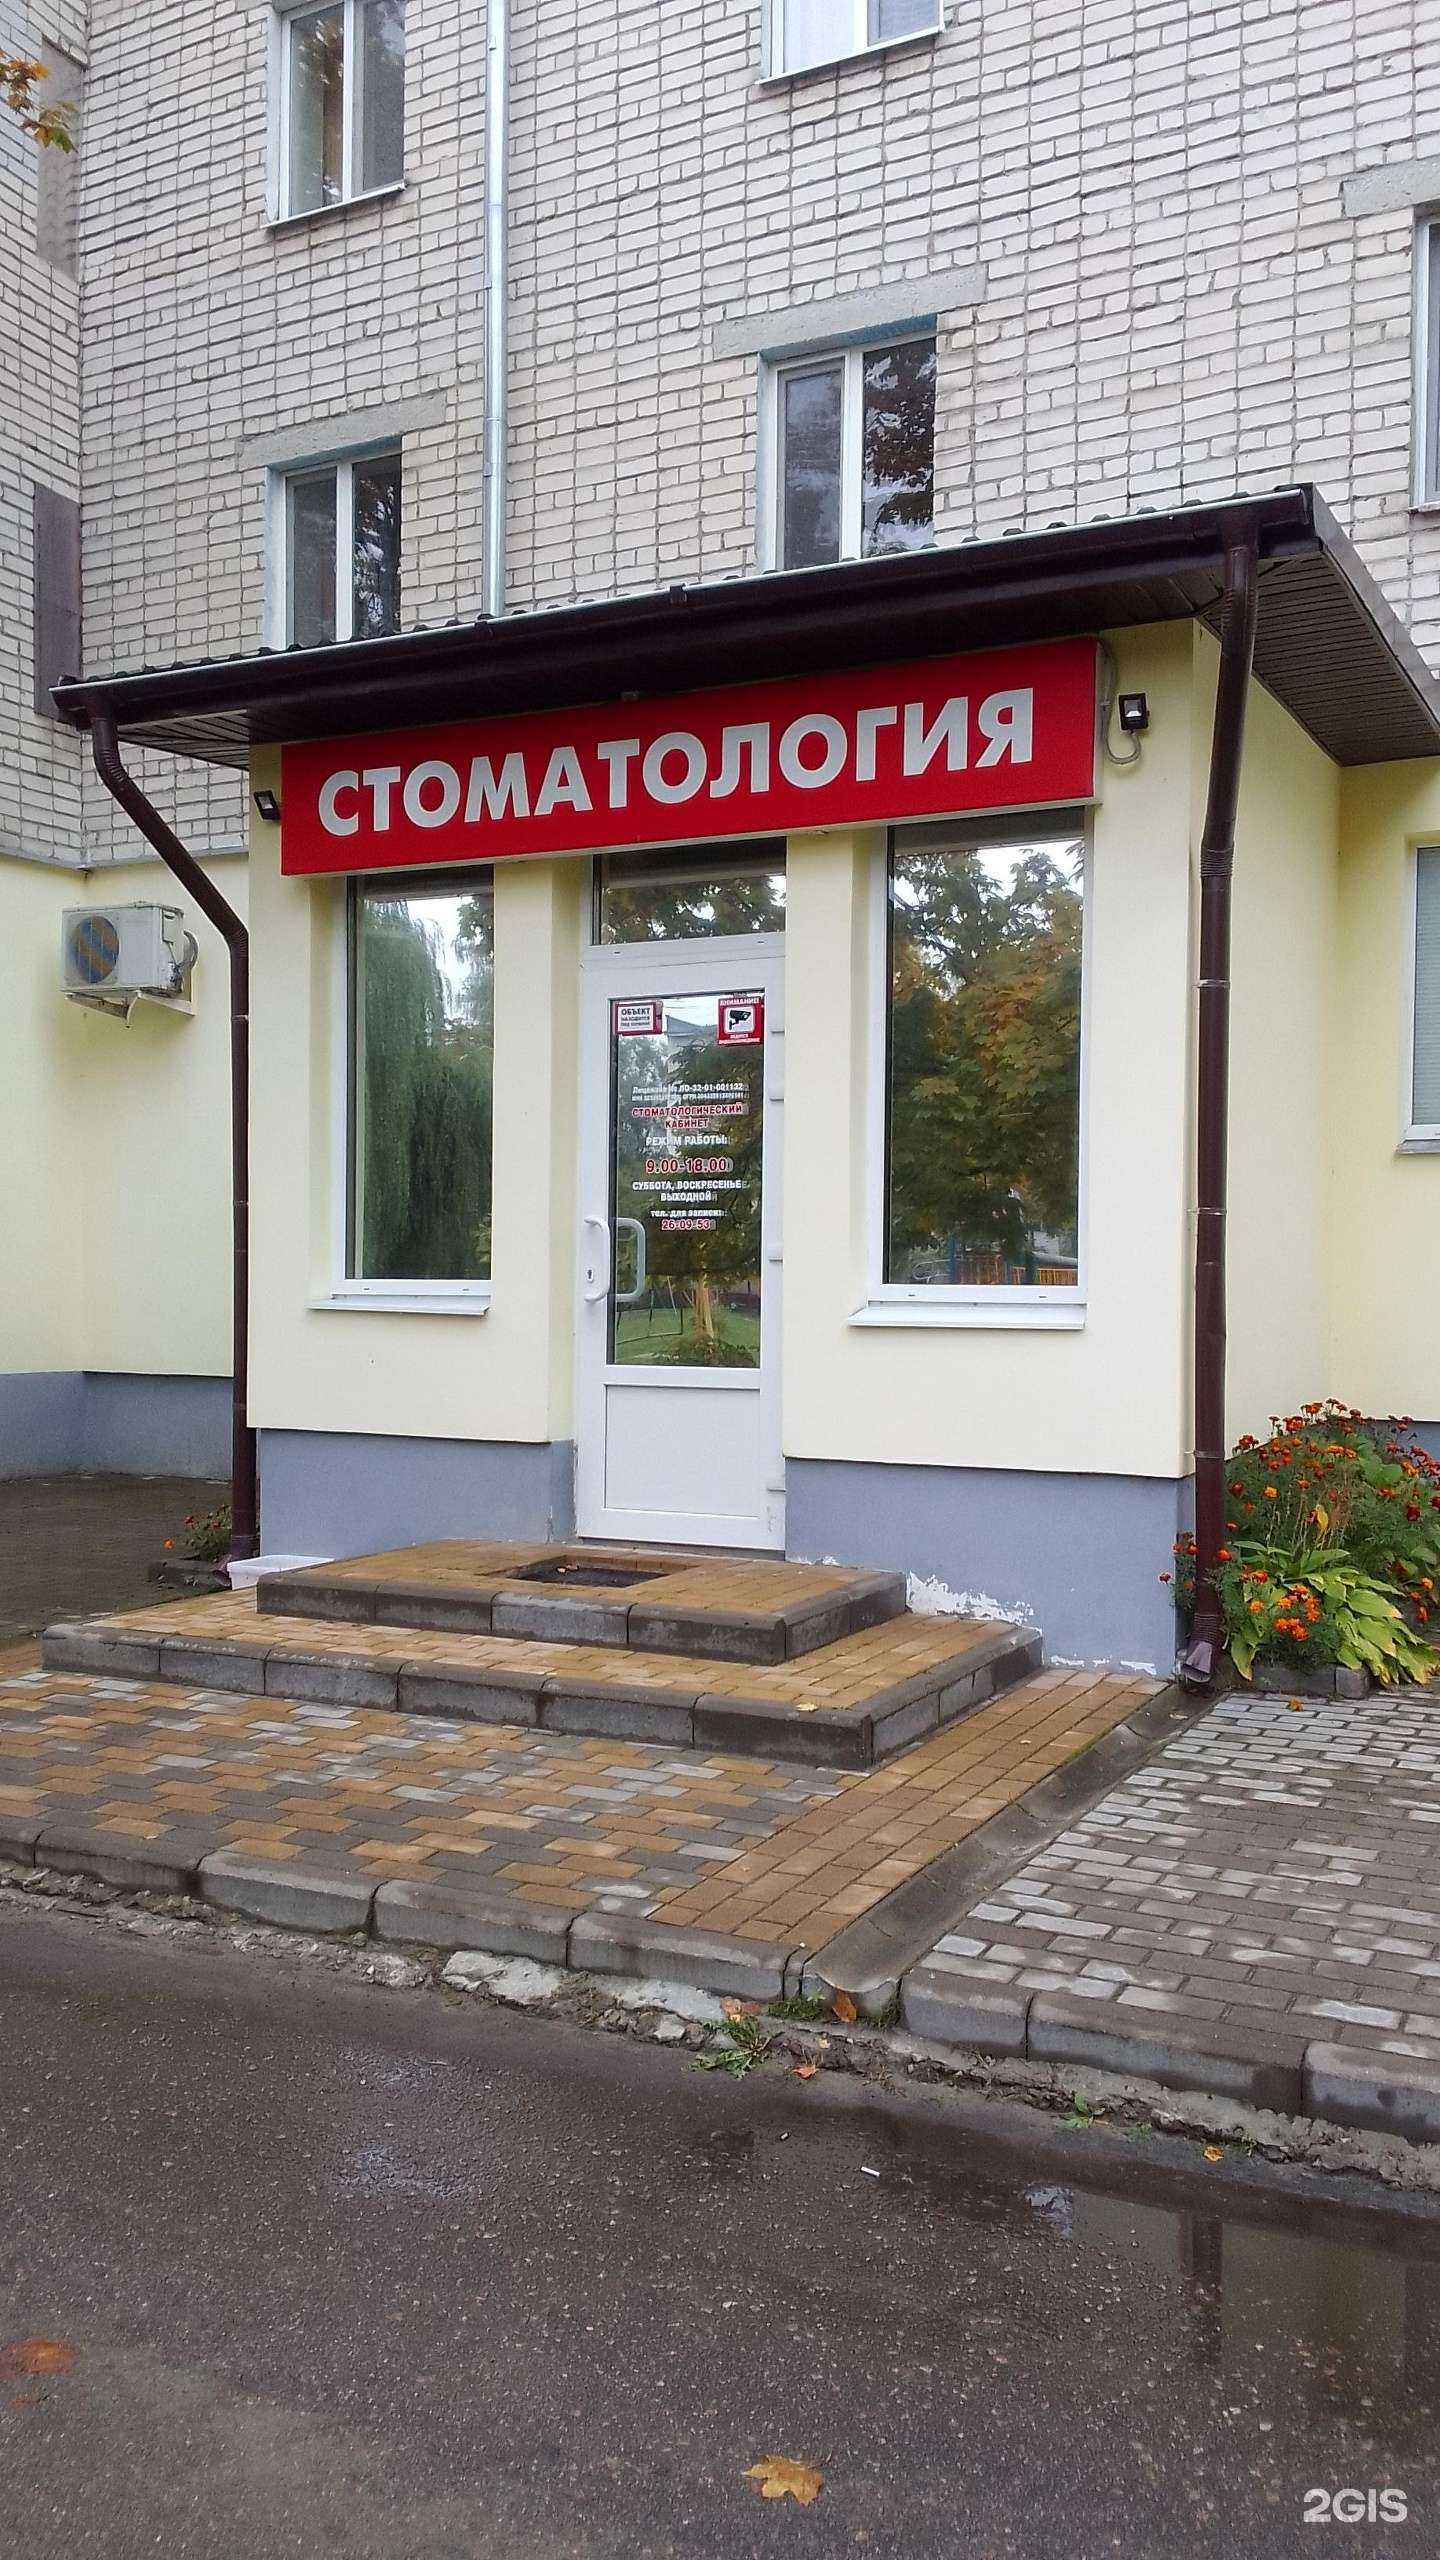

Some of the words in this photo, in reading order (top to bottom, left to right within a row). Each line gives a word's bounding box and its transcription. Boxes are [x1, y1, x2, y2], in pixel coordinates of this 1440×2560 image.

[318, 688, 1034, 837] СТОМАТОЛОГИЯ
[621, 1007, 650, 1016] ОБЪЕКТ
[632, 1102, 743, 1117] СТОМАТОЛОГИЧЕСКИЙ
[665, 1118, 709, 1129] КАБИНЕТ
[645, 1136, 681, 1146] РЕЖИМ
[684, 1134, 728, 1145] РАБОТЫ:
[677, 1180, 742, 1190] ВОСКРЕСЕНЬЕ
[661, 1190, 712, 1202] ВЫХОДНОЙ
